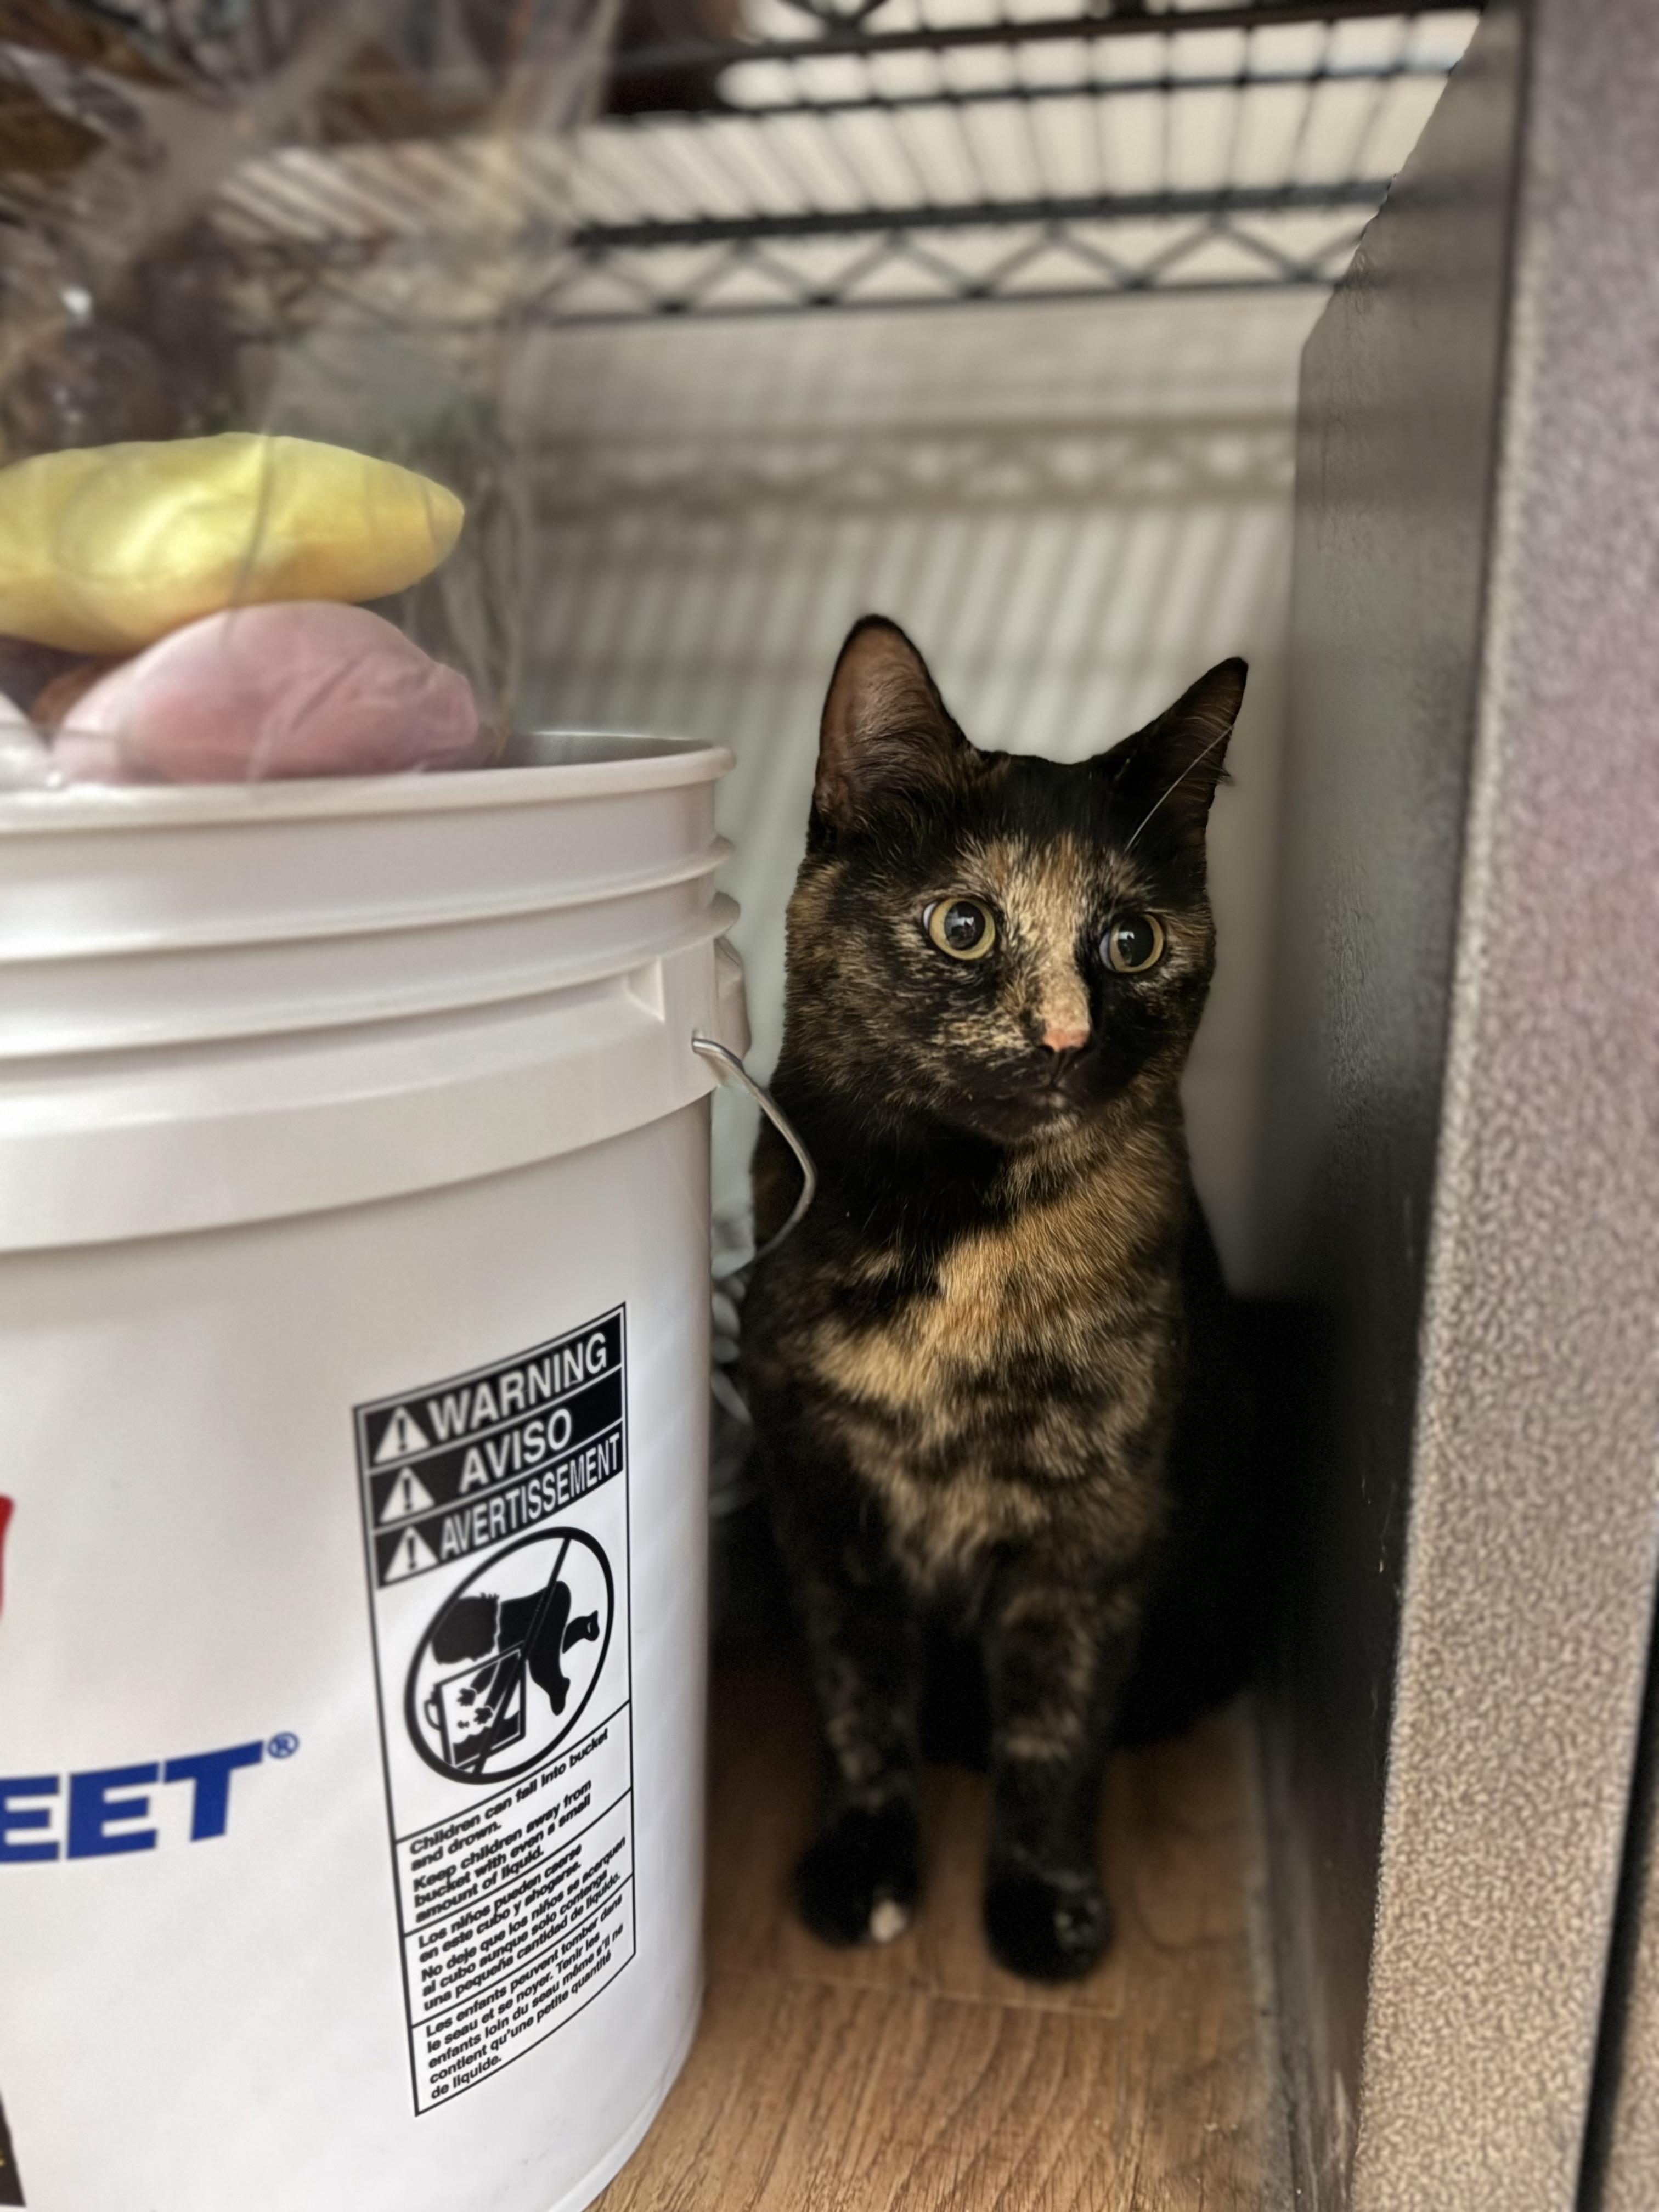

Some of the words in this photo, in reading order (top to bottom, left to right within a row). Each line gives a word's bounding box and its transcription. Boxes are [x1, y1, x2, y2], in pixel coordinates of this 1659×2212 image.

[427, 1332, 607, 1441] WARNING
[441, 1432, 620, 1560] AVERTISSEMENT
[459, 1408, 572, 1494] AVISO
[410, 1814, 481, 1854] Children
[484, 1797, 512, 1819] can
[516, 1778, 537, 1803] fall
[541, 1763, 566, 1787] into
[569, 1728, 607, 1768] bucket
[413, 1864, 456, 1892] Keep
[461, 1829, 522, 1869] children
[527, 1803, 560, 1833] away
[563, 1780, 591, 1808] from
[411, 1846, 443, 1871] and
[448, 1821, 501, 1854] drown.
[415, 1871, 470, 1908] bucket
[474, 1853, 506, 1878] with
[511, 1831, 544, 1858] even
[548, 1822, 555, 1836] a
[558, 1793, 590, 1827] small
[416, 1883, 478, 1922] amount
[482, 1871, 497, 1889] of
[501, 1845, 544, 1880] liquid.
[419, 1927, 447, 1949] Los
[451, 1905, 490, 1933] niños
[494, 1874, 541, 1915] pueden
[419, 1946, 439, 1963] en
[442, 1929, 473, 1951] este
[477, 1908, 510, 1934] cubo
[514, 1900, 521, 1916] y
[524, 1861, 582, 1906] ahogarse.
[421, 1965, 443, 1982] No
[447, 1946, 477, 1969] deje
[480, 1930, 506, 1952] que
[509, 1916, 528, 1936] los
[532, 1891, 564, 1920] niños
[567, 1878, 580, 1895] se
[423, 1979, 436, 1996] al
[440, 1962, 476, 1988] cubo
[479, 1931, 528, 1968] aunque
[531, 1911, 557, 1935] solo
[560, 1869, 607, 1915] contenga
[424, 1990, 452, 2011] una
[455, 1955, 514, 1999] pequeña
[517, 1914, 568, 1960] cantidad
[570, 1905, 584, 1921] de
[426, 2017, 453, 2038] Les
[456, 1987, 507, 2022] enfants
[511, 1949, 558, 1994] peuvent
[561, 1917, 598, 1955] tomber
[601, 1894, 622, 1922] dans
[427, 2040, 441, 2053] le
[444, 2019, 478, 2044] seau
[481, 2008, 494, 2024] et
[498, 1999, 514, 2015] se
[516, 1972, 553, 2003] noyer.
[556, 1946, 583, 1974] Tenir
[585, 1932, 600, 1951] les
[428, 2034, 482, 2068] enfants
[484, 2017, 509, 2039] loin
[512, 2004, 529, 2021] du
[532, 1981, 560, 2008] seau
[612, 1923, 623, 1942] ne
[430, 2045, 487, 2084] contient
[490, 2016, 534, 2051] qu'une
[537, 1990, 569, 2023] petite
[431, 2084, 449, 2099] de
[453, 2055, 501, 2089] liquide.
